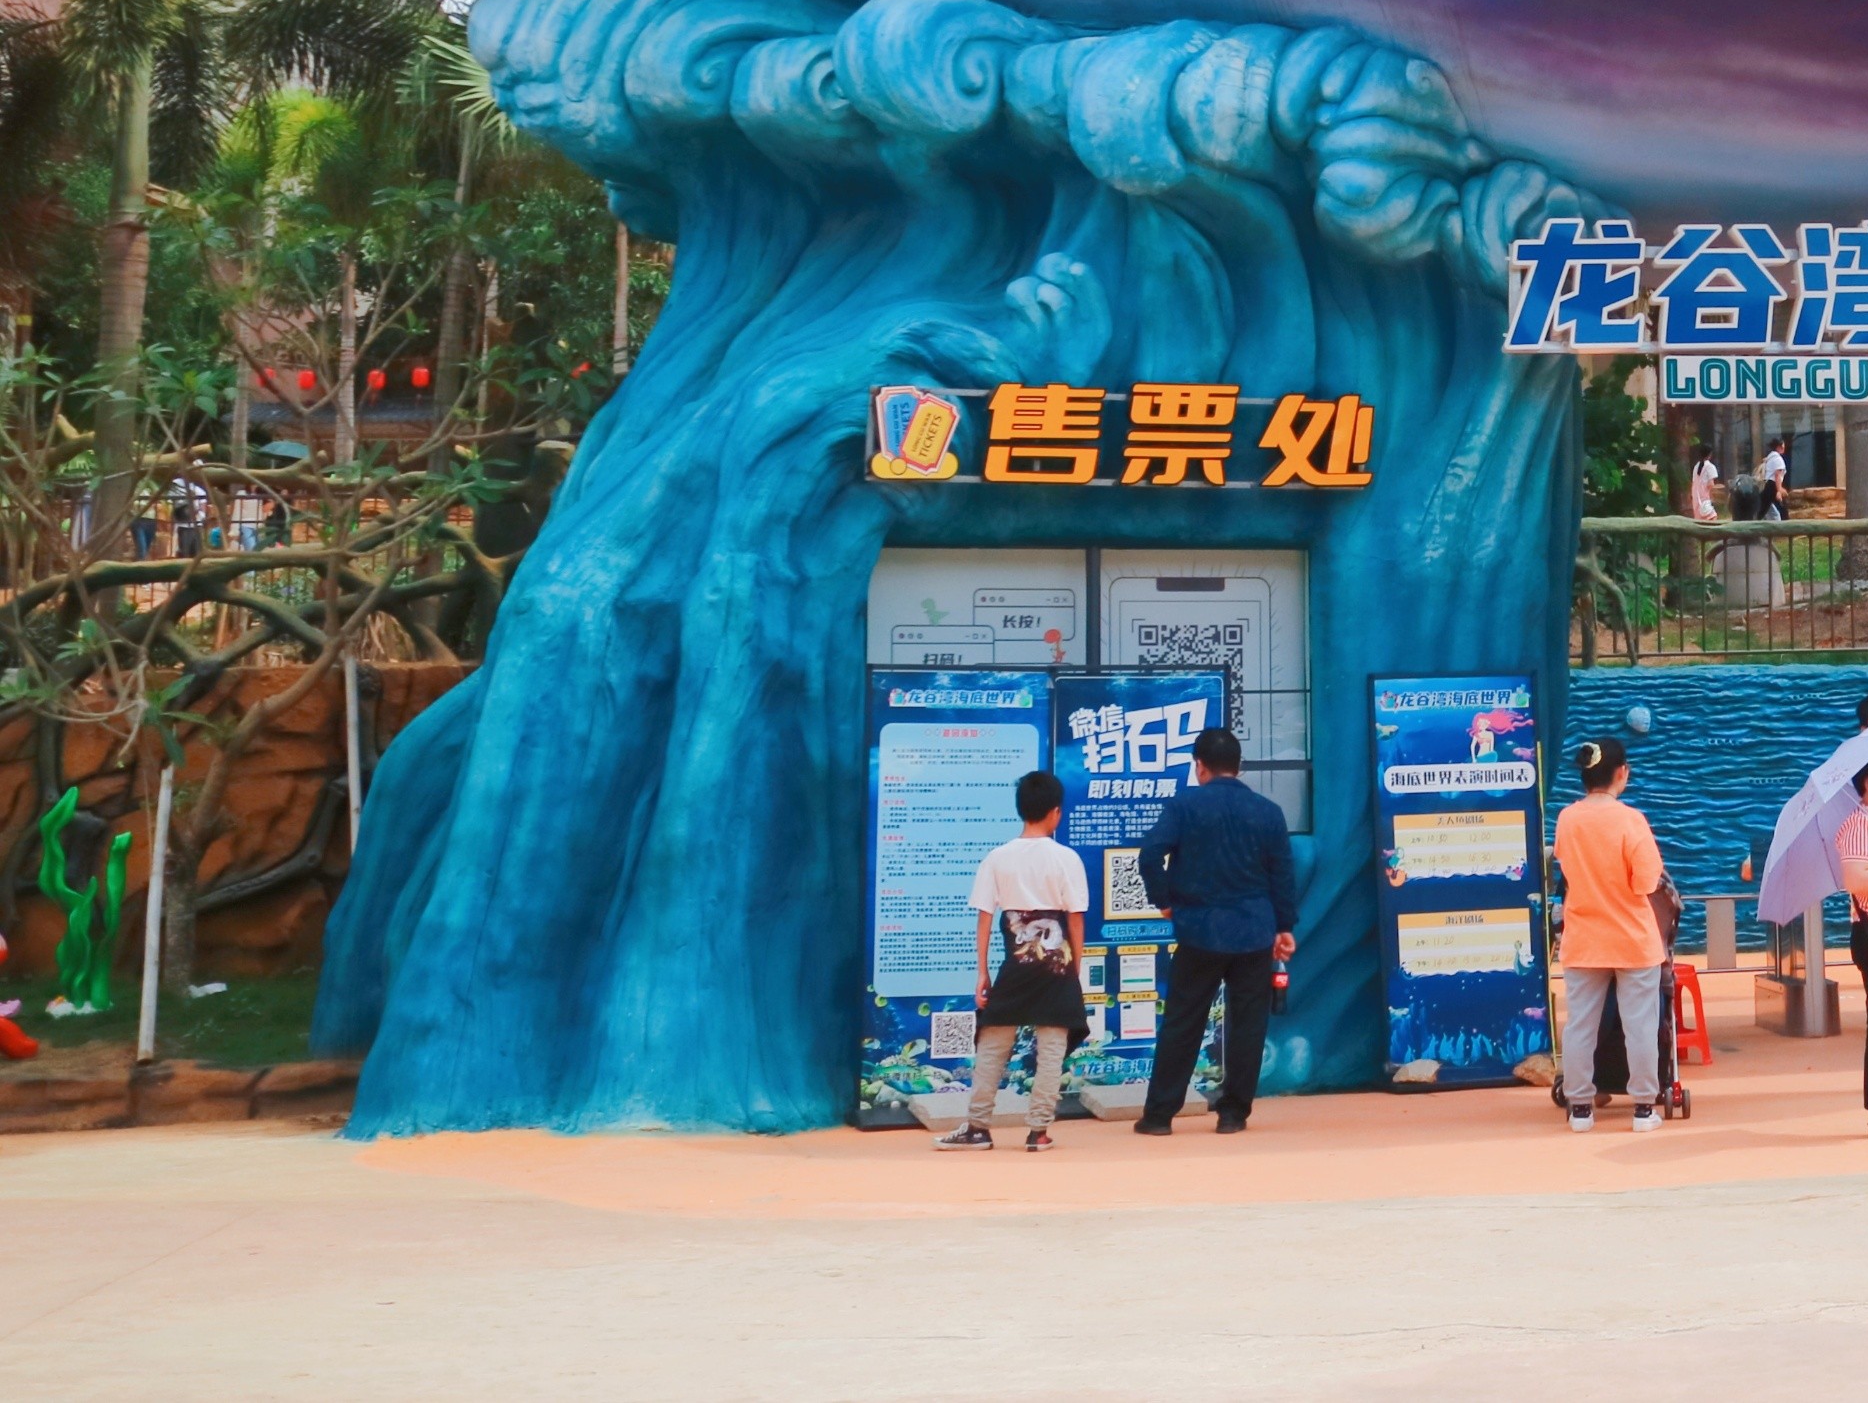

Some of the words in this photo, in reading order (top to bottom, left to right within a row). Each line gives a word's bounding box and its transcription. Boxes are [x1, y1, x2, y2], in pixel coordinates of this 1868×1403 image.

[918, 414, 942, 457] TICKETS
[984, 382, 1373, 488] 售票处
[908, 689, 1017, 704] 龙谷湾海底世界
[1400, 689, 1511, 706] 龙谷湾海底世界
[1068, 703, 1125, 739] 微信
[1082, 698, 1208, 787] 扫码
[1087, 778, 1178, 799] 即刻购票
[1391, 769, 1528, 787] 海底世界表演时间表
